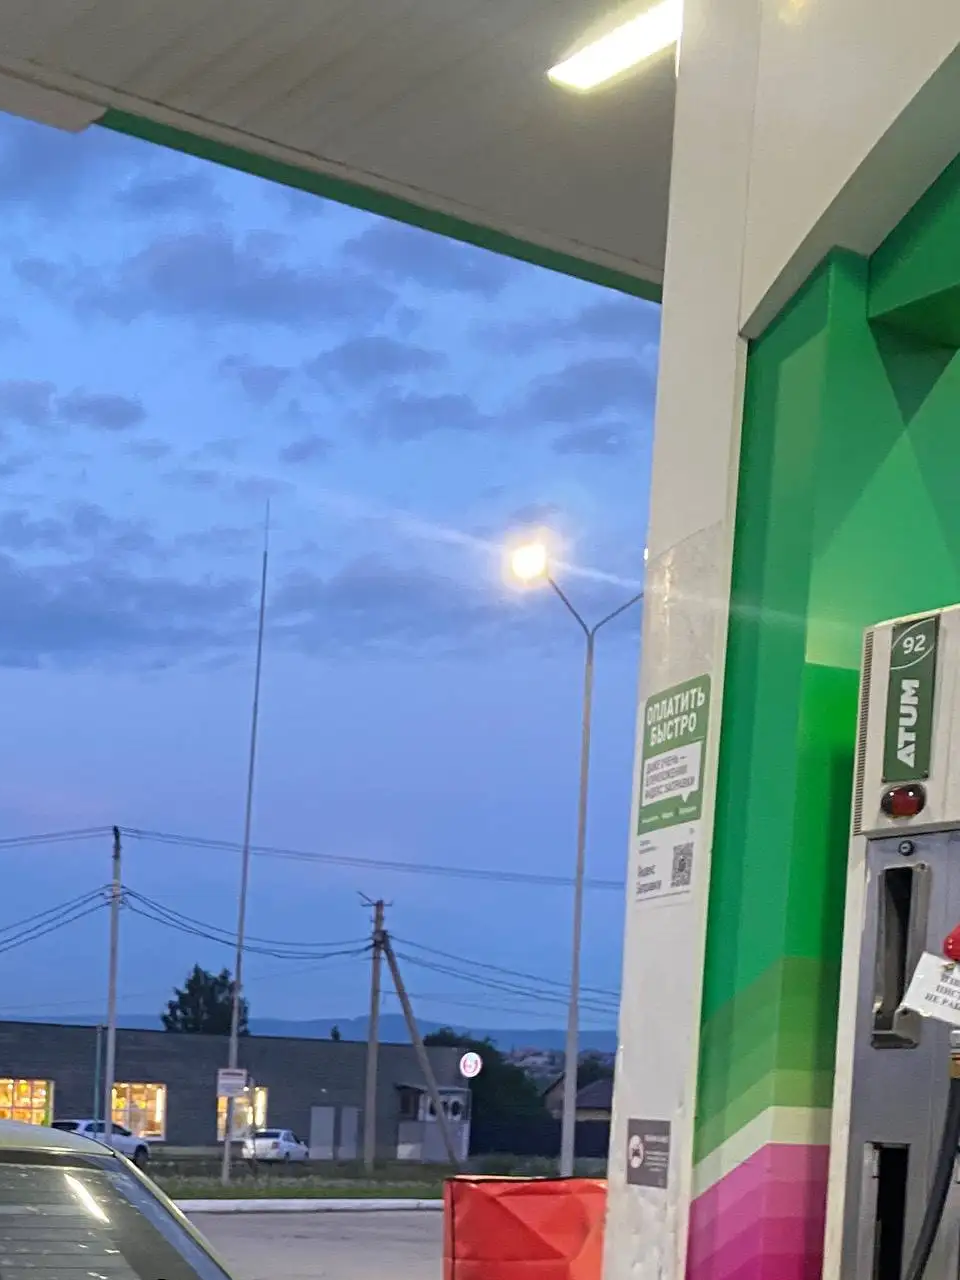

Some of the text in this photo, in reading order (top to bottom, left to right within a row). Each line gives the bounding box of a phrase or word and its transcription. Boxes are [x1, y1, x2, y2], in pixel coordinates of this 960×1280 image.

[902, 634, 926, 654] 92
[647, 687, 705, 726] ОПЛАТИТЬ
[896, 678, 920, 768] ATUM
[650, 711, 697, 746] БЫСТРО
